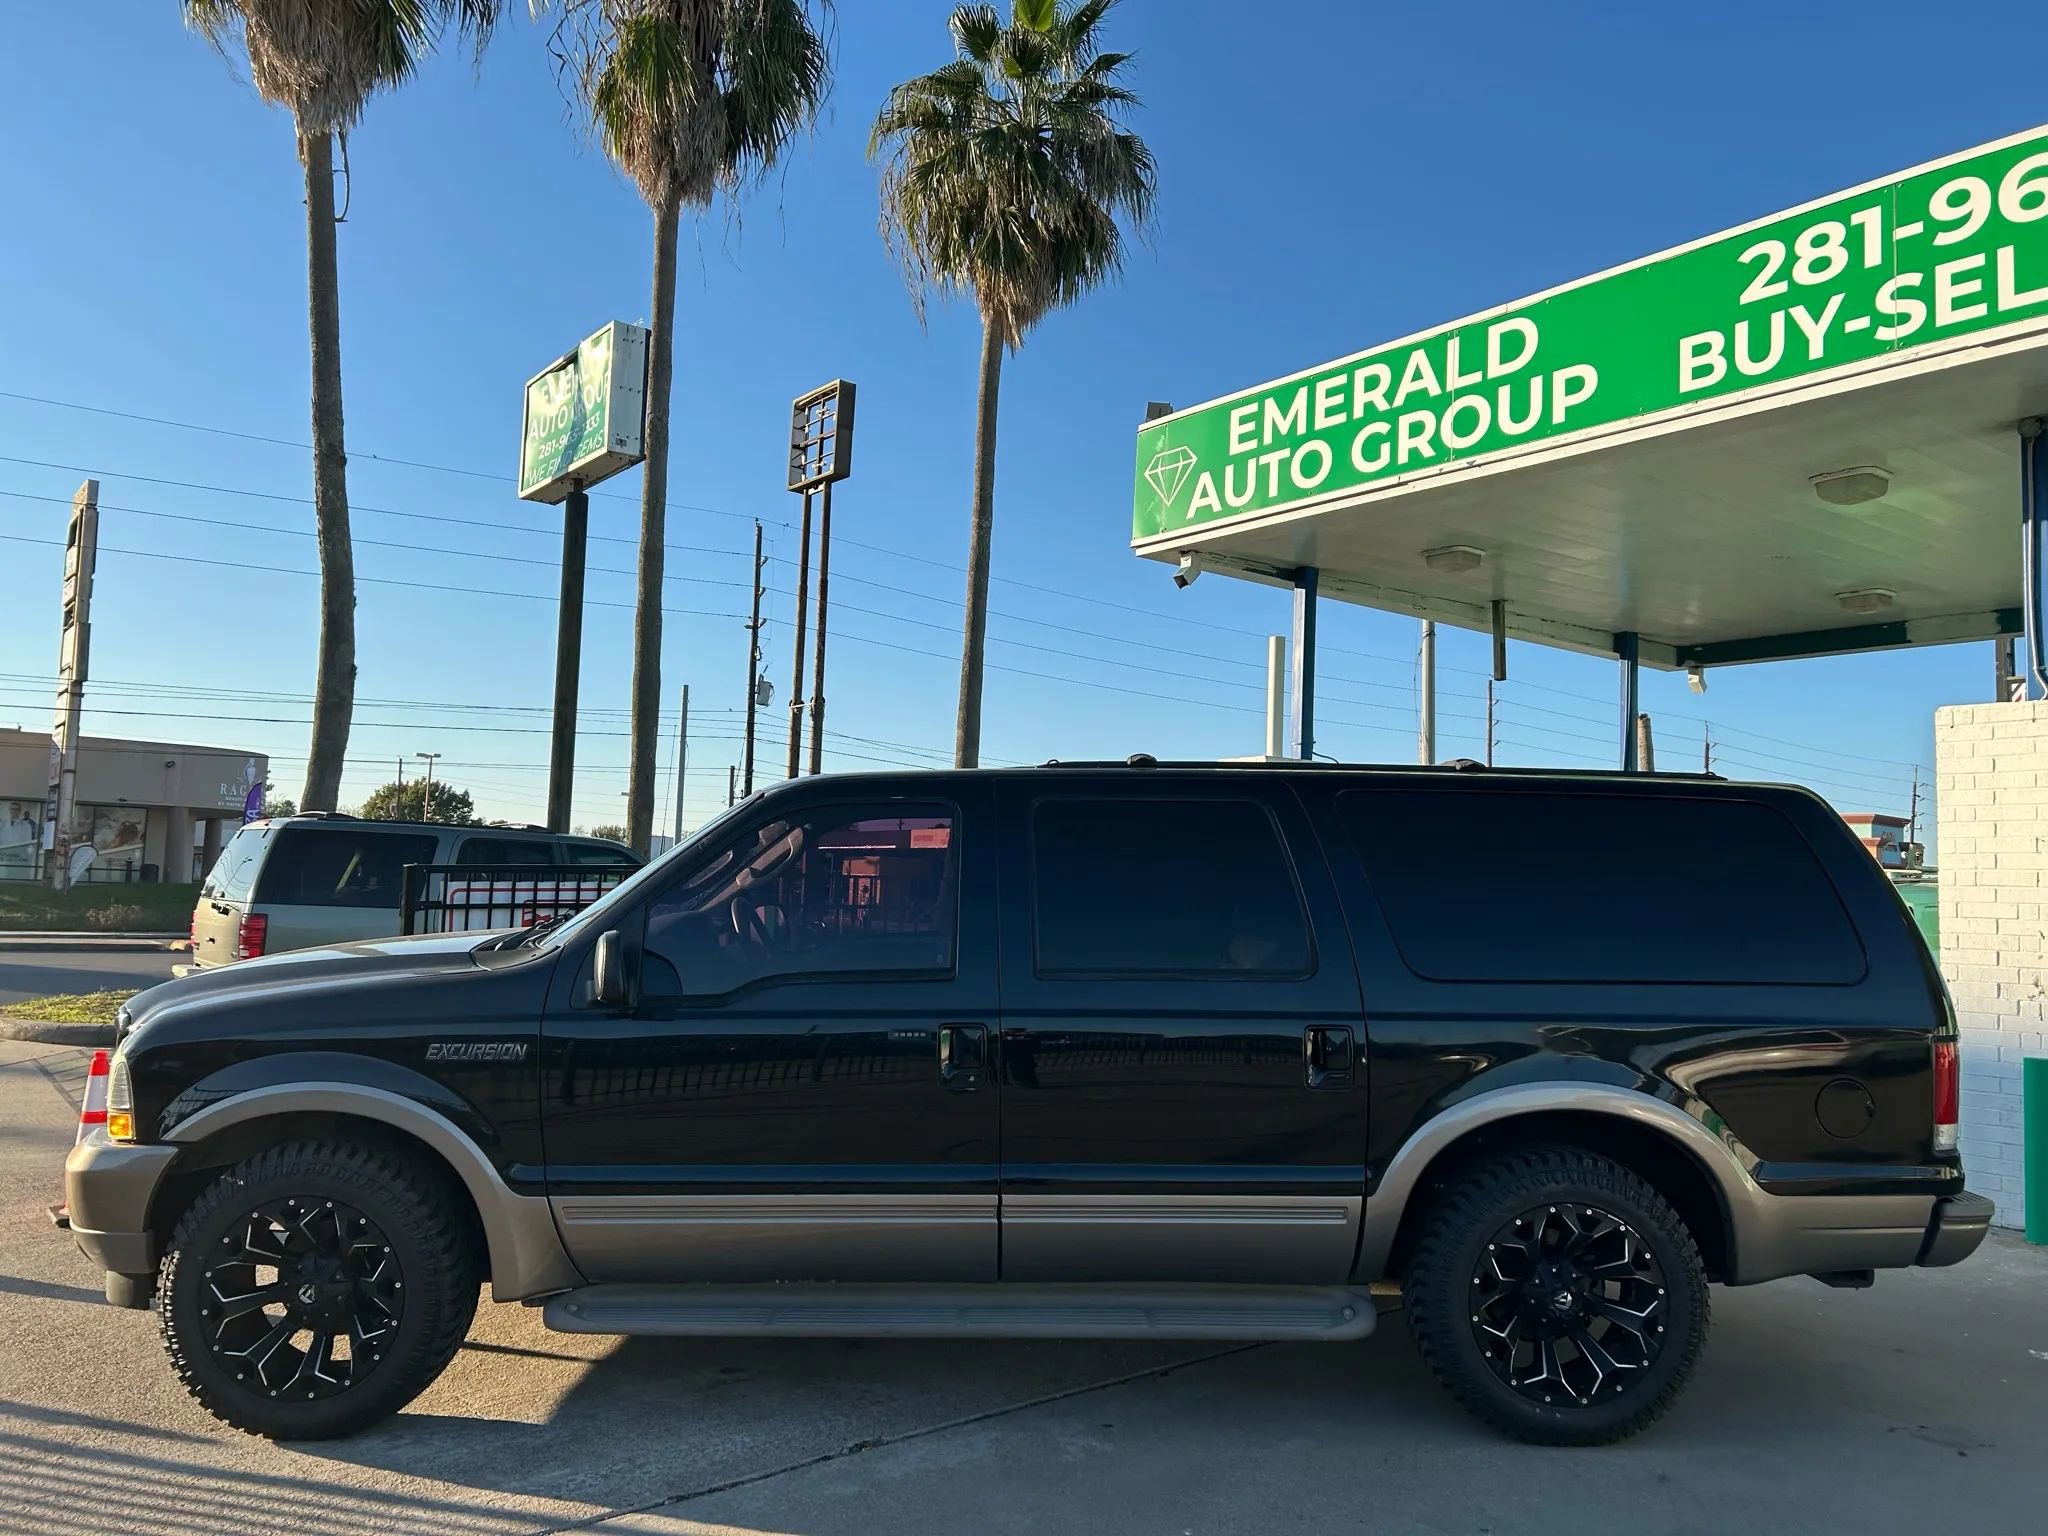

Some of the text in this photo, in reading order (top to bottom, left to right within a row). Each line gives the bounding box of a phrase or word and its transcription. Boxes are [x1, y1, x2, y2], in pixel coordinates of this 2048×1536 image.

[1186, 363, 1599, 520] AUTO GROUP
[1229, 317, 1539, 456] EMERALD
[426, 1043, 528, 1060] EXCURSION
